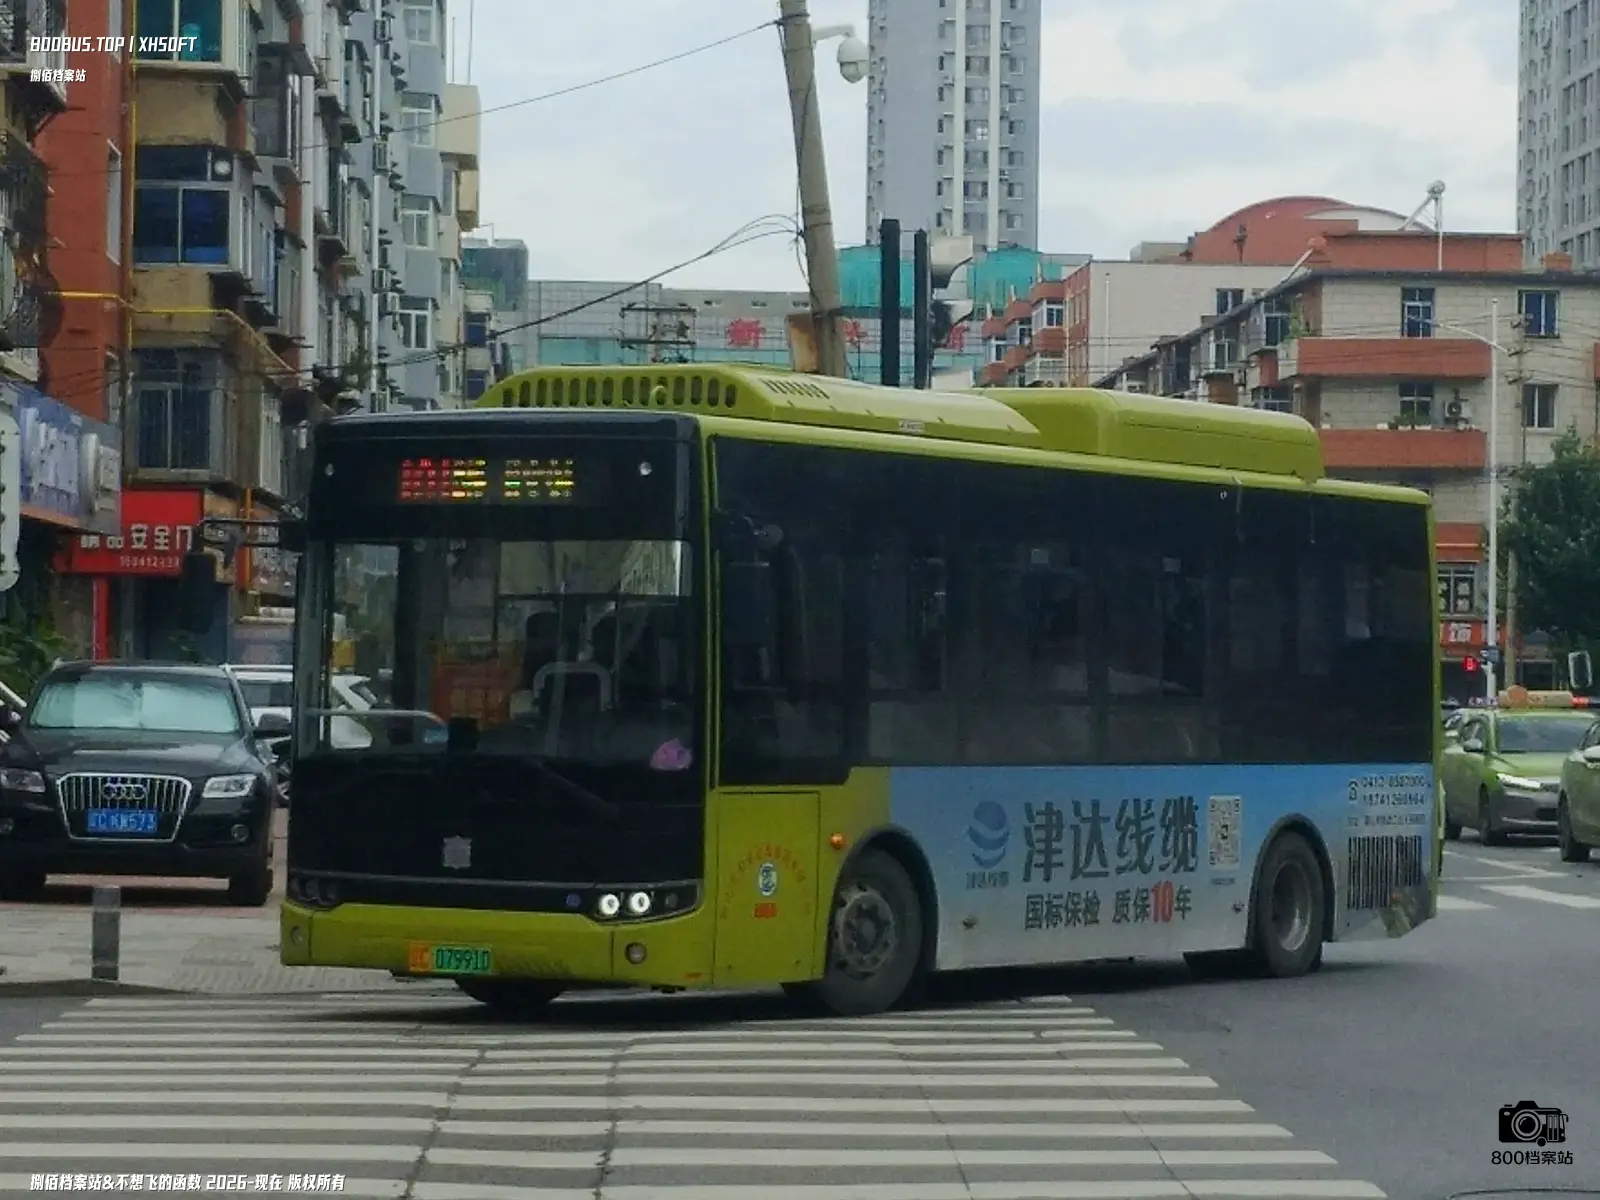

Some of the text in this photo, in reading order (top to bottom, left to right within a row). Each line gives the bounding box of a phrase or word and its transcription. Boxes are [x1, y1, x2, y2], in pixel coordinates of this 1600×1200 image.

[1022, 796, 1199, 883] 津达线缆
[1024, 880, 1192, 931] 国标保检 质保10年
